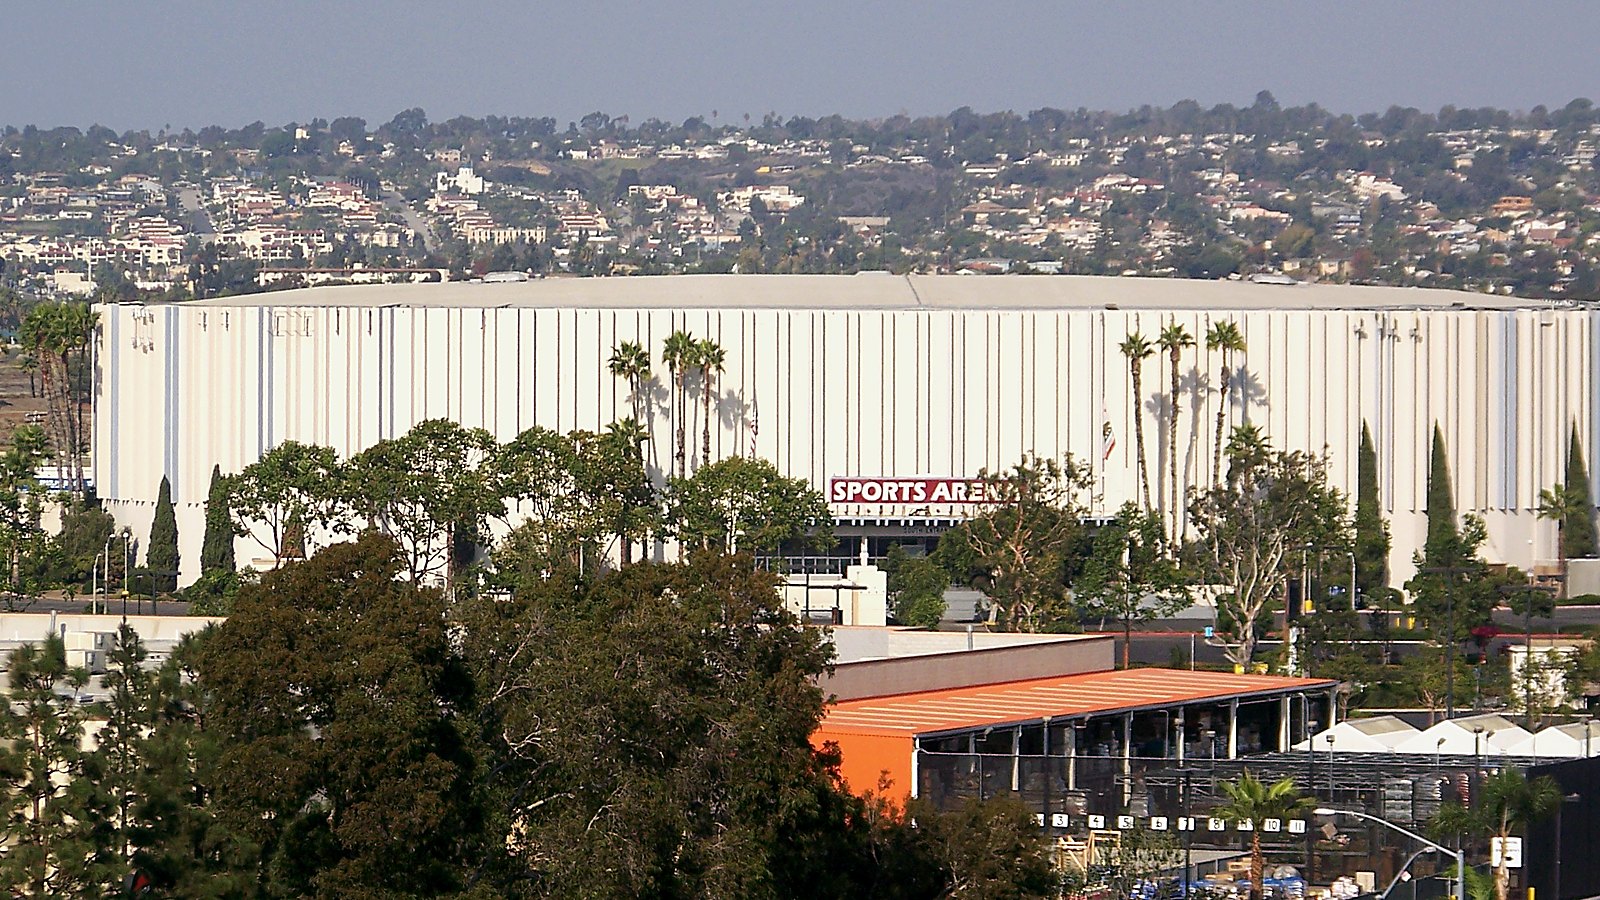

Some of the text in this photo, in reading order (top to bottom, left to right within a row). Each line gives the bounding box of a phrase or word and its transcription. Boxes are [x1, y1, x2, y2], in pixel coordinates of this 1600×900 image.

[833, 481, 926, 501] SPORTS
[1056, 815, 1064, 826] 3
[1093, 816, 1100, 828] 4
[1156, 818, 1163, 828] 6
[1213, 819, 1221, 829] 8
[1268, 820, 1278, 830] 10
[1295, 822, 1302, 831] 11
